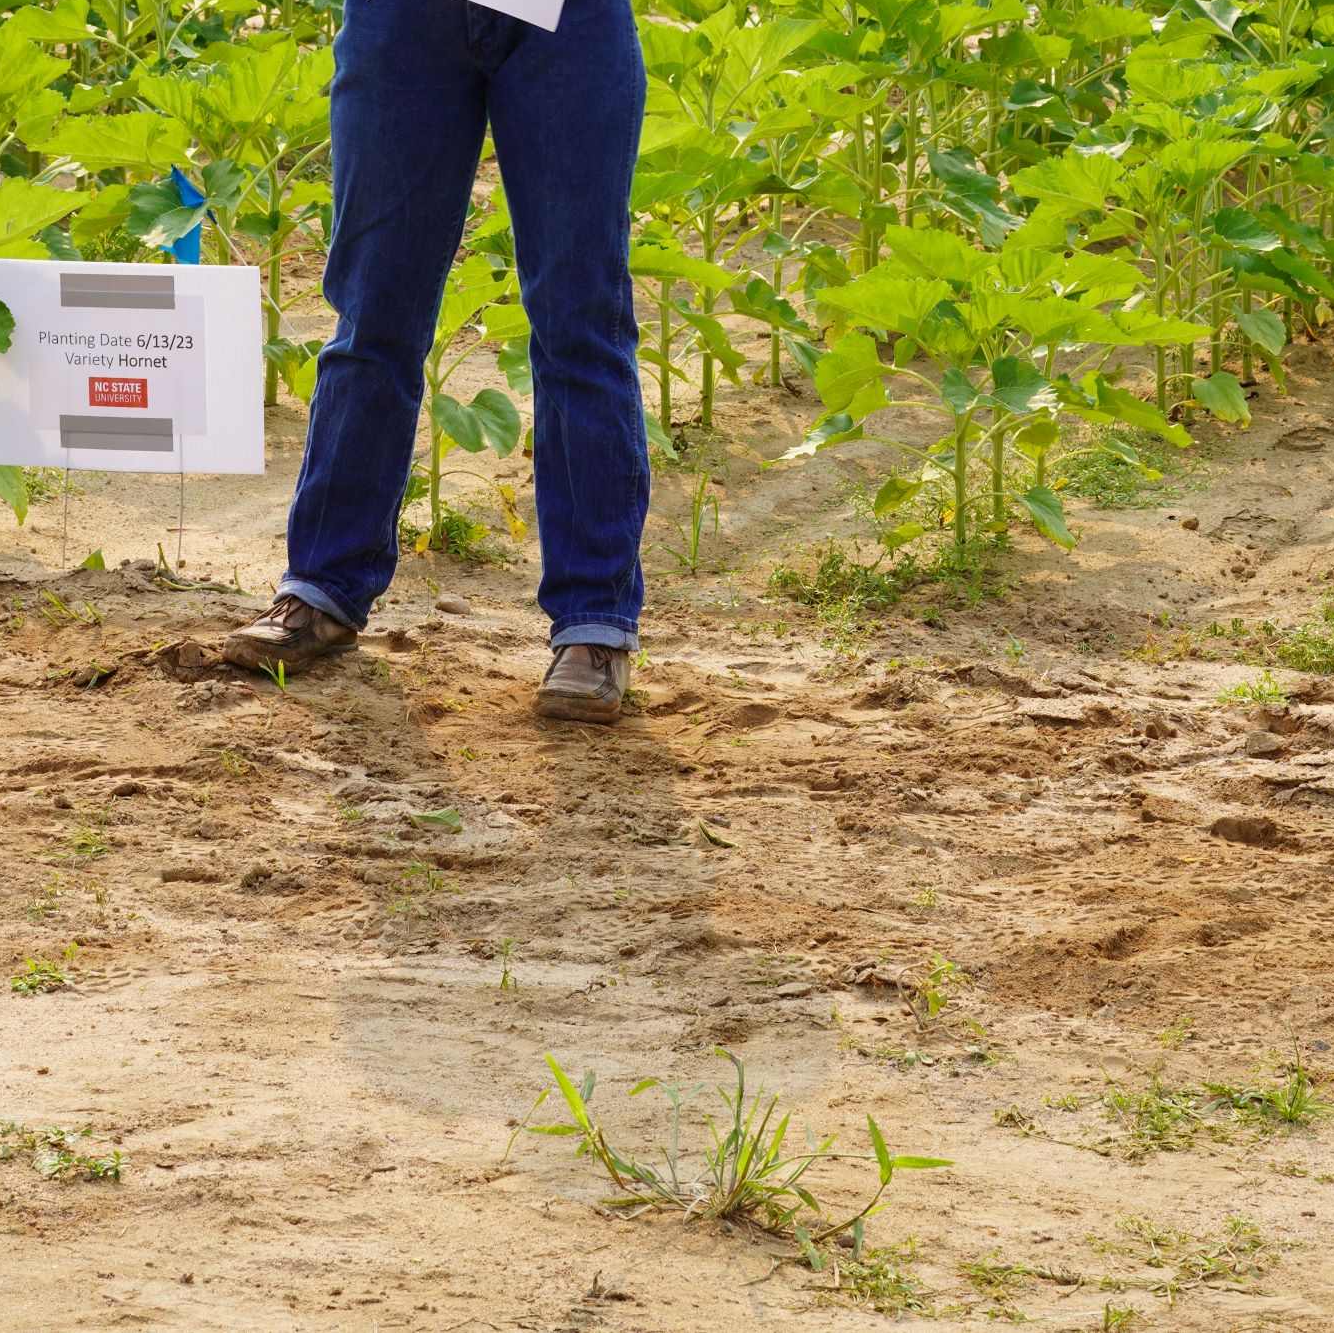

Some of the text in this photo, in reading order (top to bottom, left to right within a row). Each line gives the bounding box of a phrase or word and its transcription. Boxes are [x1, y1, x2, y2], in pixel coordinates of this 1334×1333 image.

[39, 331, 194, 350] Planting Date 6/13/23
[65, 352, 168, 369] Variety Hornet
[94, 381, 142, 393] NC STATE
[94, 393, 142, 403] UNIVERSITY
